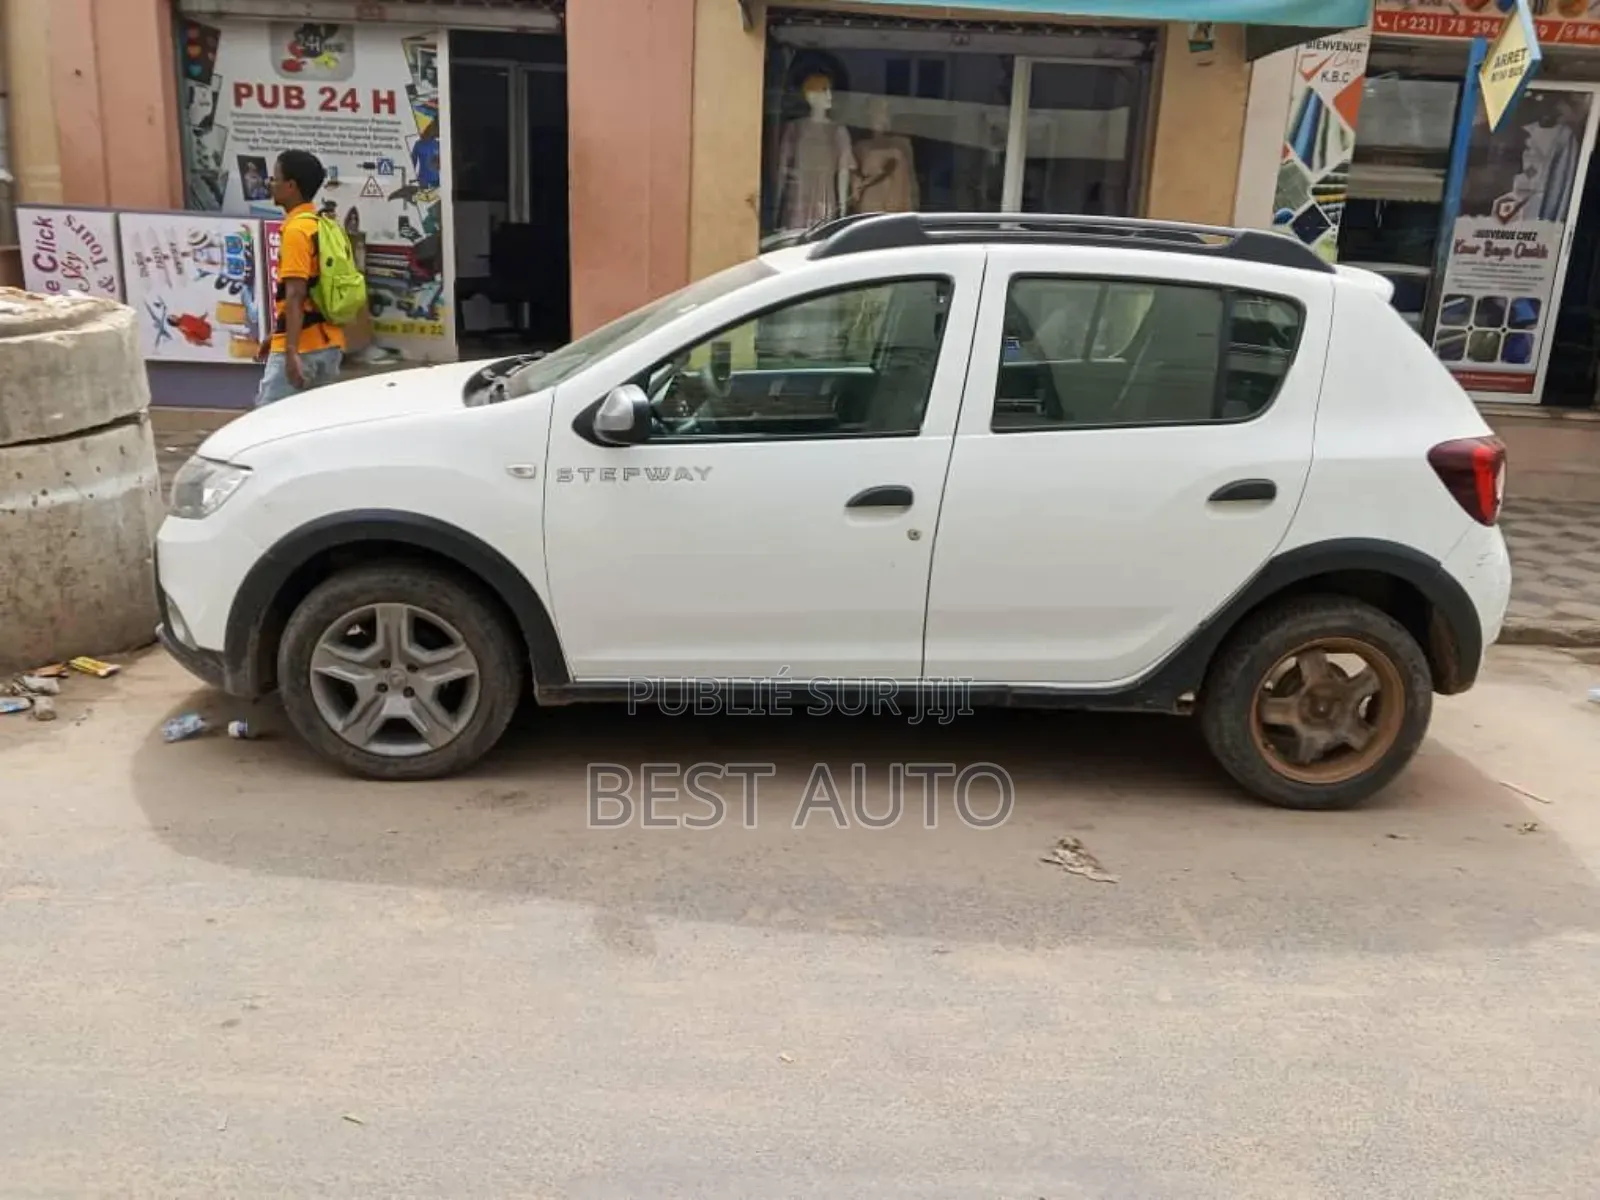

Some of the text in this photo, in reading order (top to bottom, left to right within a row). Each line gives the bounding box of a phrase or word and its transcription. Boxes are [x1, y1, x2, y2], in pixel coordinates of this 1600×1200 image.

[233, 82, 397, 115] PUB 24 H
[32, 215, 59, 273] Click
[63, 214, 109, 271] Tours
[556, 466, 713, 483] STEPWAY
